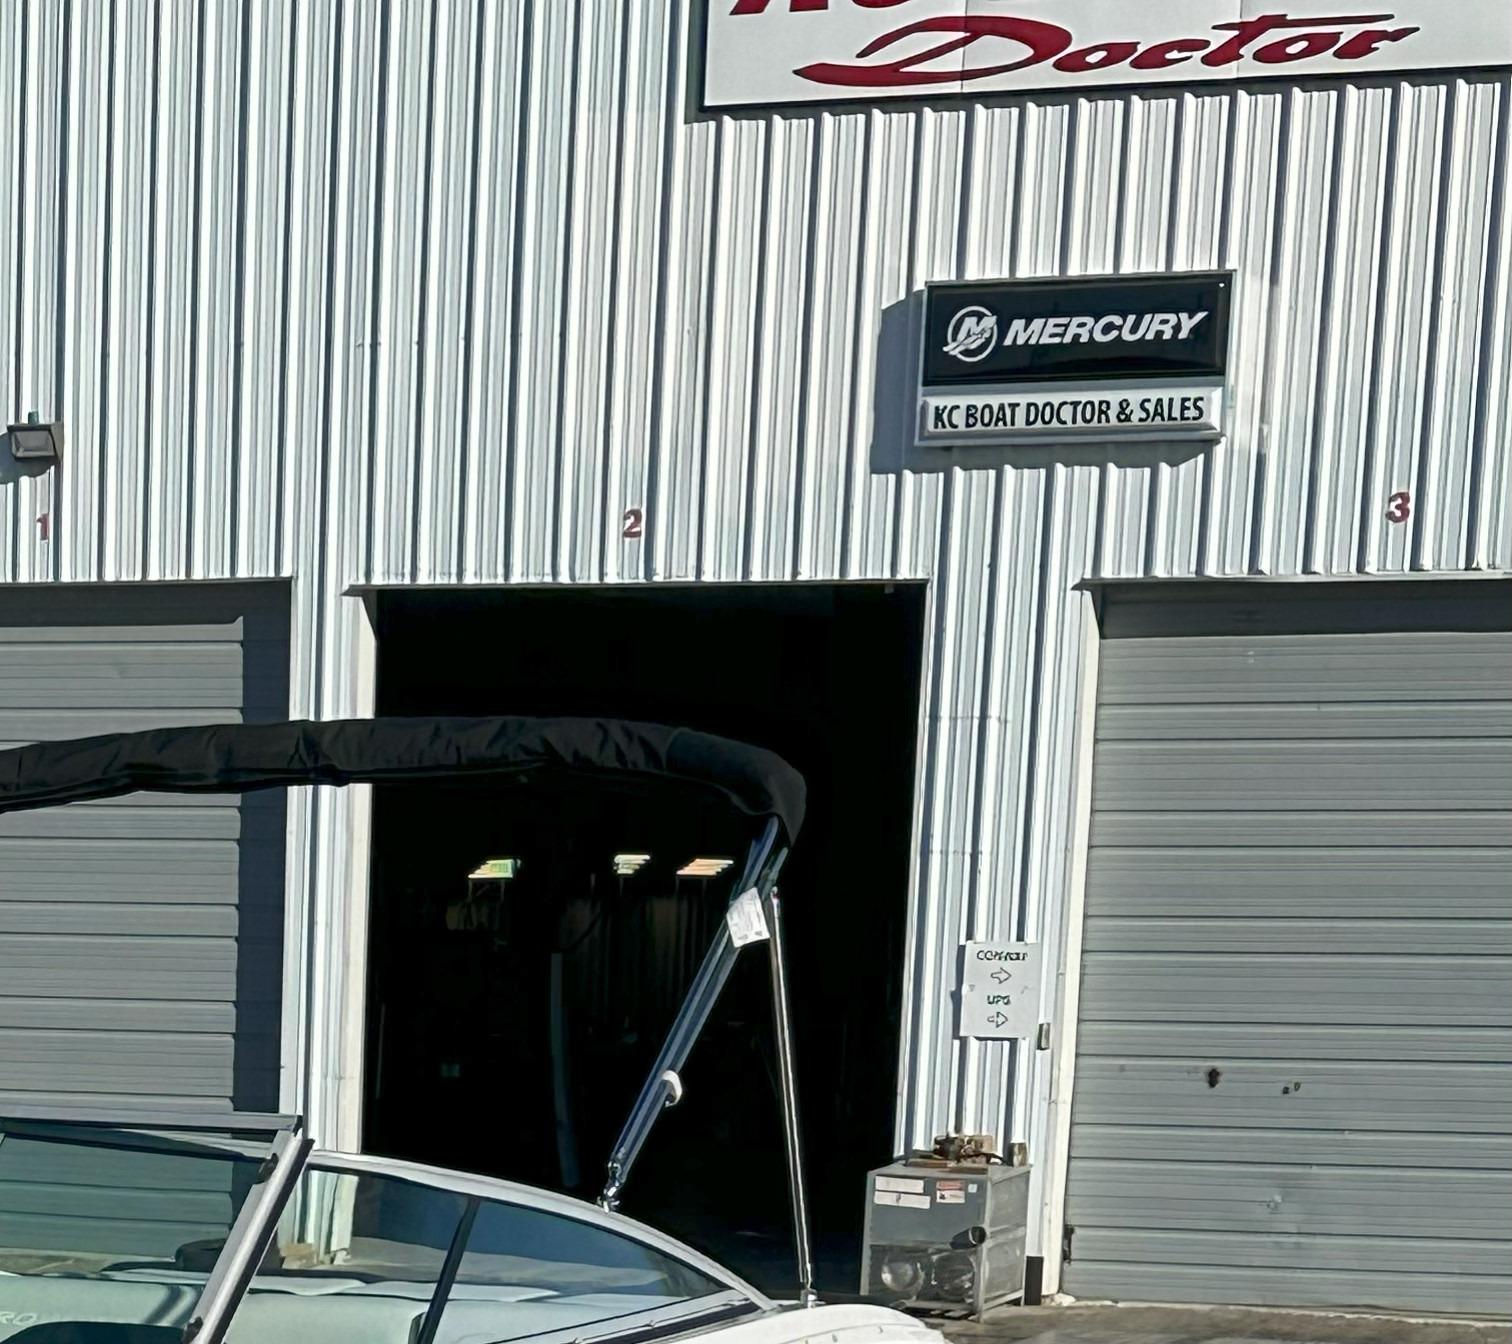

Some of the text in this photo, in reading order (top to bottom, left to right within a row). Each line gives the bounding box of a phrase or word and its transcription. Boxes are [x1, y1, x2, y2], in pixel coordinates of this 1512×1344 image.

[792, 14, 1420, 87] Doctor
[1003, 311, 1209, 346] MERCURY
[933, 396, 1205, 430] KC BOAT DOCTOR & SALES
[622, 509, 642, 538] 2
[1385, 492, 1410, 523] 3
[36, 512, 50, 542] 1
